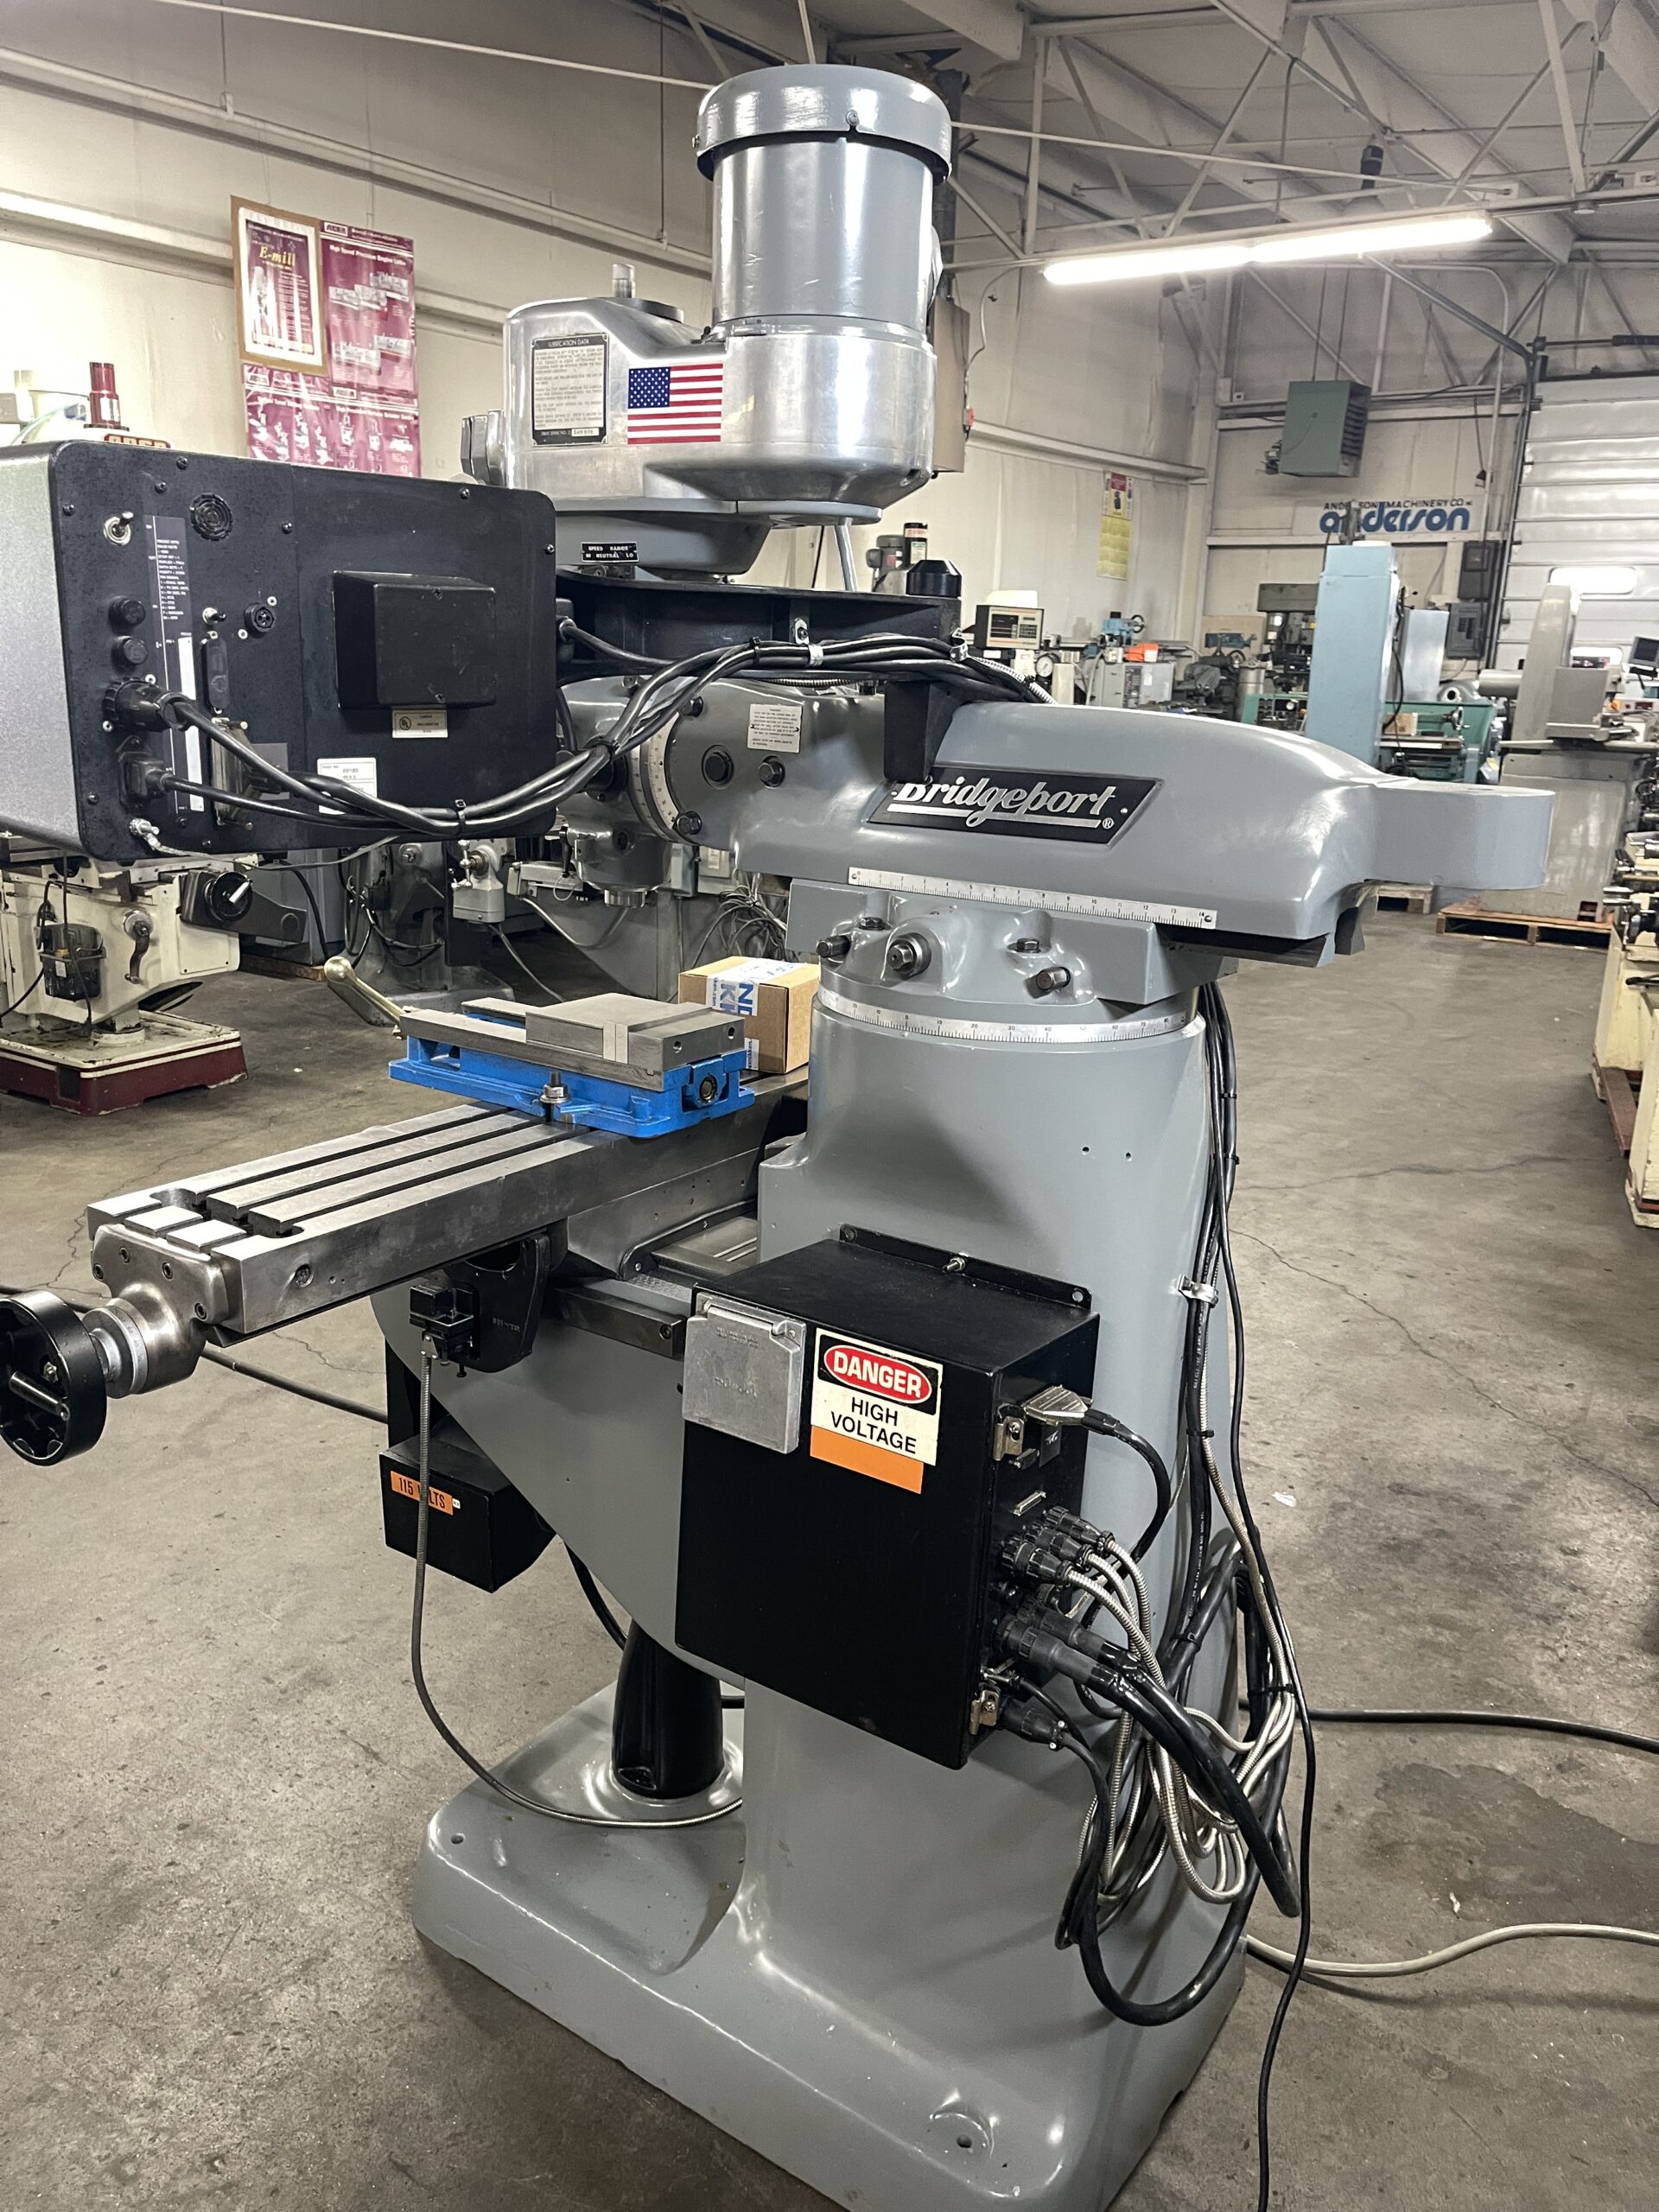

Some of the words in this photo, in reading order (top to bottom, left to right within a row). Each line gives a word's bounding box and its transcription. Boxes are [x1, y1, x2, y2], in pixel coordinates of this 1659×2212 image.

[259, 245, 296, 266] E-mill
[1319, 501, 1471, 534] aderson
[1324, 501, 1377, 510] ANDSON
[1386, 499, 1447, 508] MACHINERY
[833, 1351, 922, 1398] DANGER
[851, 1396, 898, 1426] HIGH
[830, 1410, 917, 1454] VOLTAGE
[398, 1478, 414, 1496] 115
